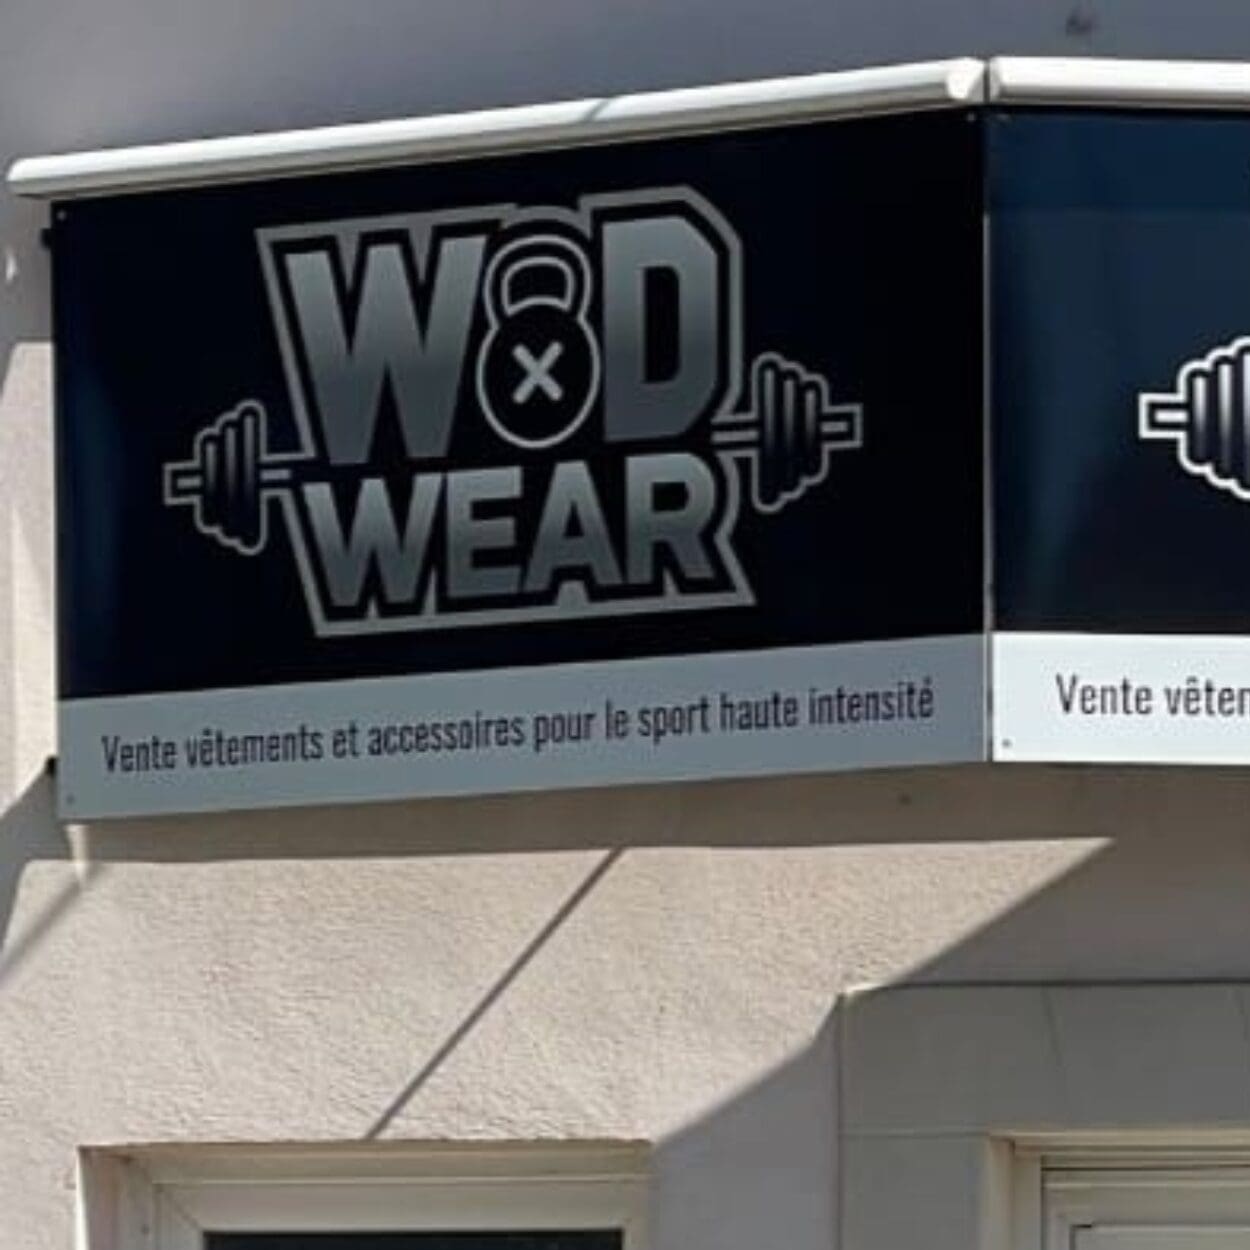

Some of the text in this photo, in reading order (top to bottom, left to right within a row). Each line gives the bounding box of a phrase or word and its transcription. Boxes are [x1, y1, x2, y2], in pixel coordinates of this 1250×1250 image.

[302, 451, 717, 607] WEAR
[101, 676, 933, 773] Vente vêtements et accessoires pour le sport haute intensité
[1056, 673, 1153, 715] Vente
